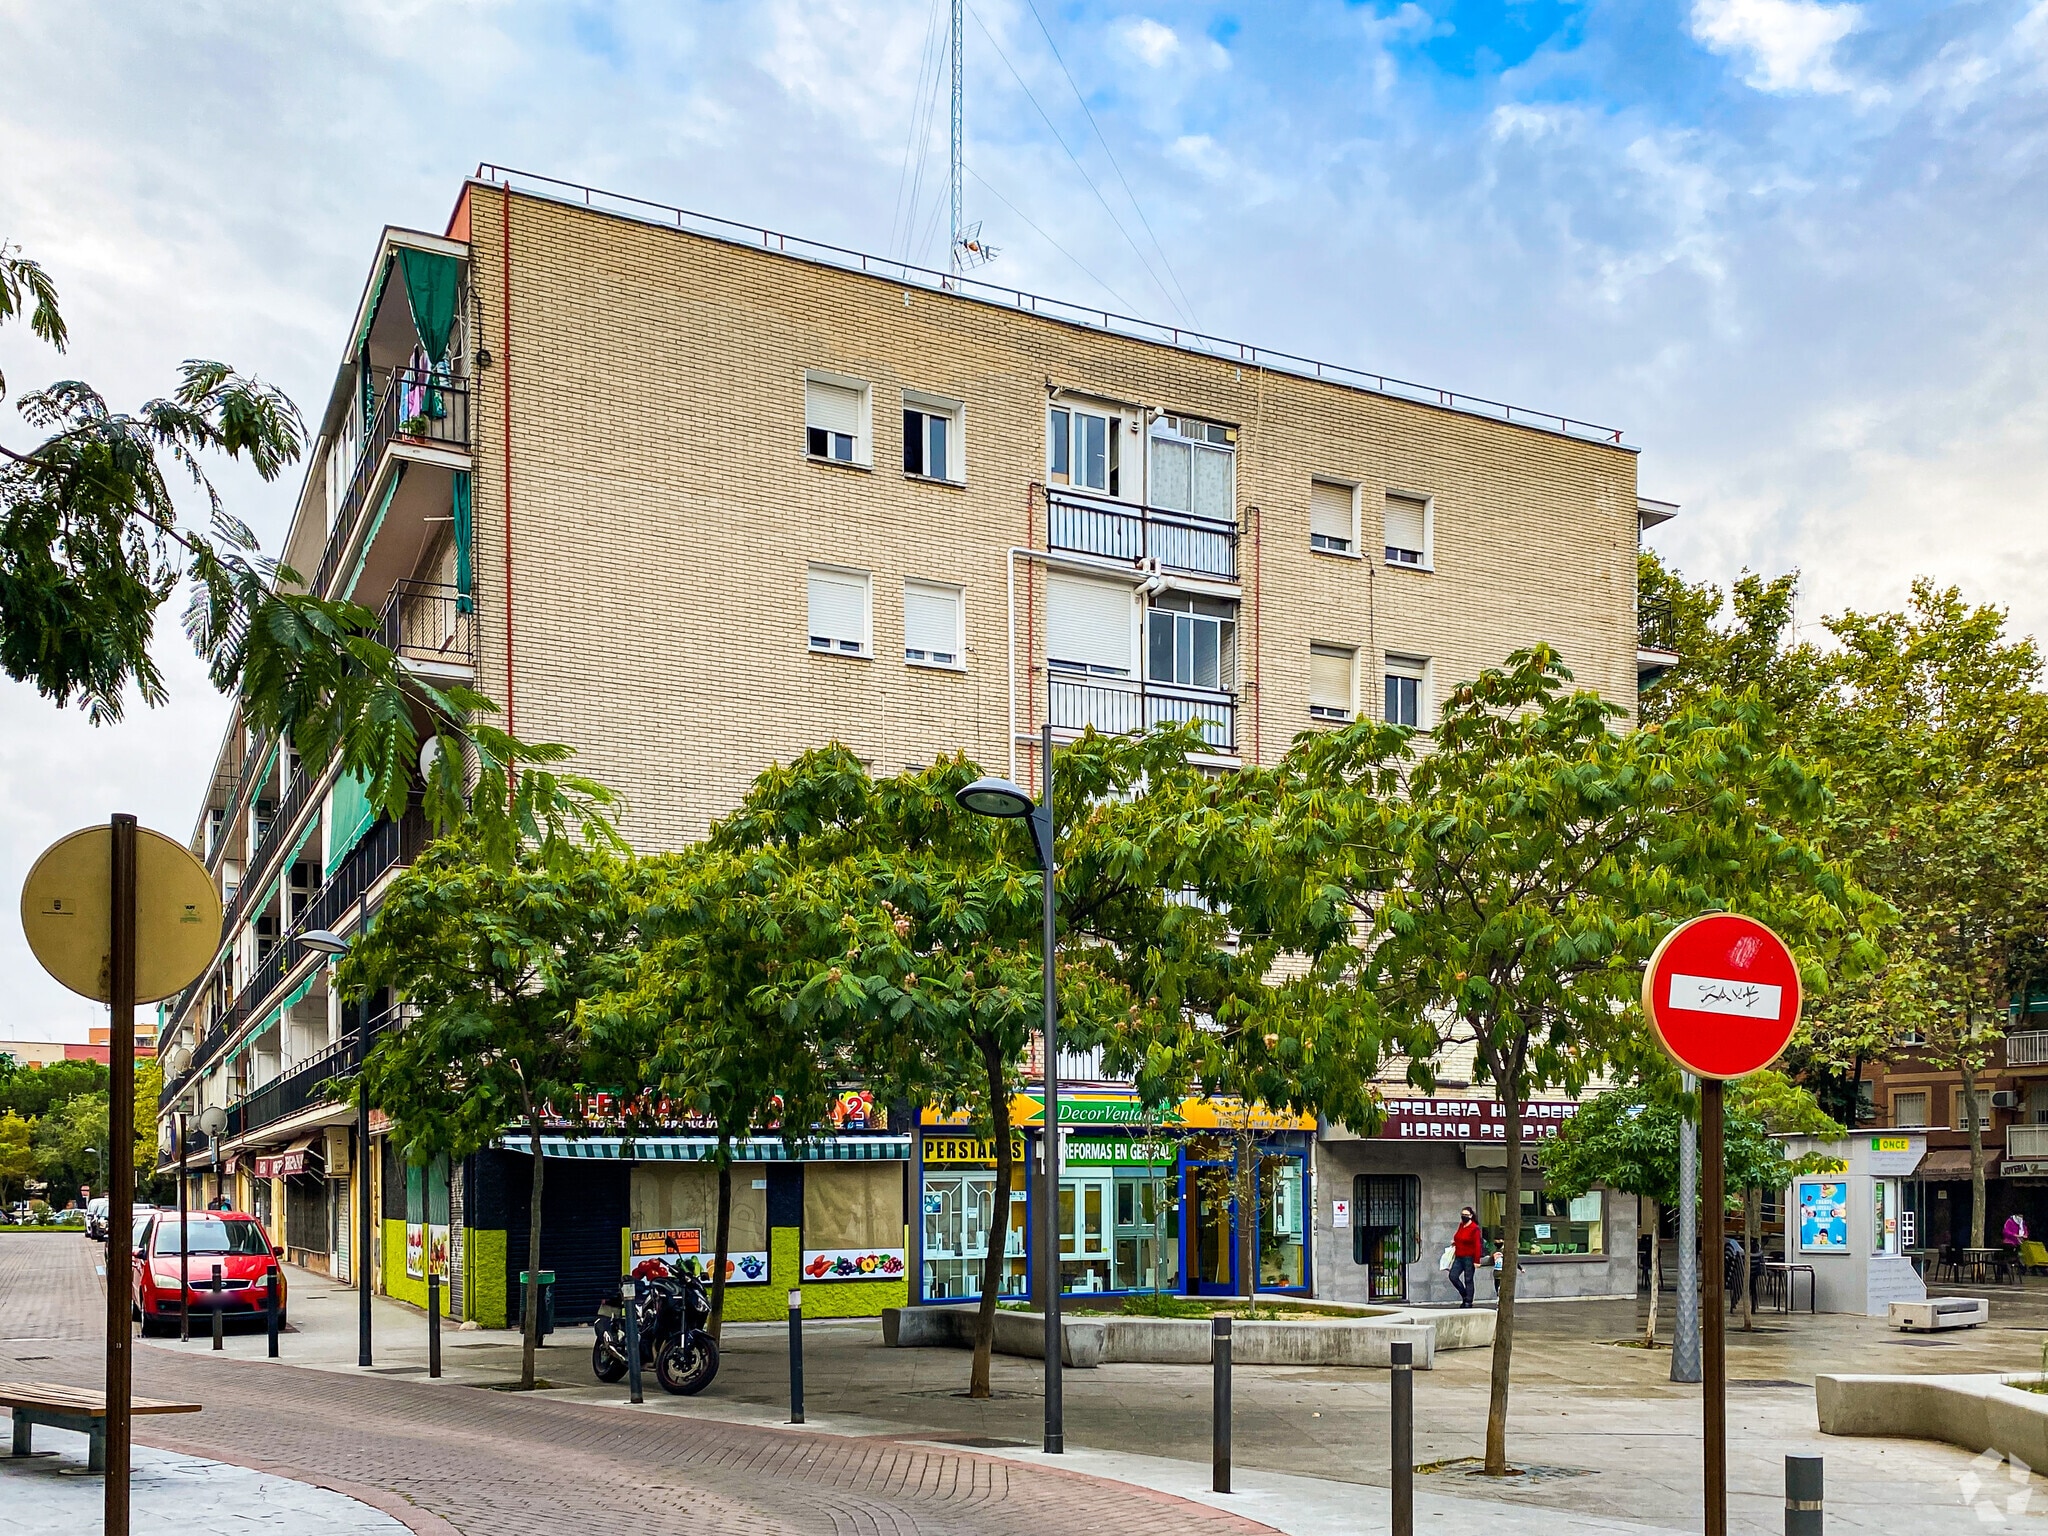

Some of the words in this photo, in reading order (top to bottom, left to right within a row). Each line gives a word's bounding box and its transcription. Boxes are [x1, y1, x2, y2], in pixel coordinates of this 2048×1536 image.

[844, 1096, 866, 1121] 2
[1400, 1122, 1470, 1137] HORNO
[1480, 1123, 1558, 1139] PRPIO
[925, 1141, 1021, 1159] PERSIANS
[1065, 1142, 1112, 1160] REFORMAS
[1115, 1143, 1127, 1159] EN
[1882, 1140, 1906, 1149] ONCE
[632, 1233, 640, 1241] SE
[641, 1231, 665, 1241] ALQUILA
[677, 1230, 699, 1239] VENDE
